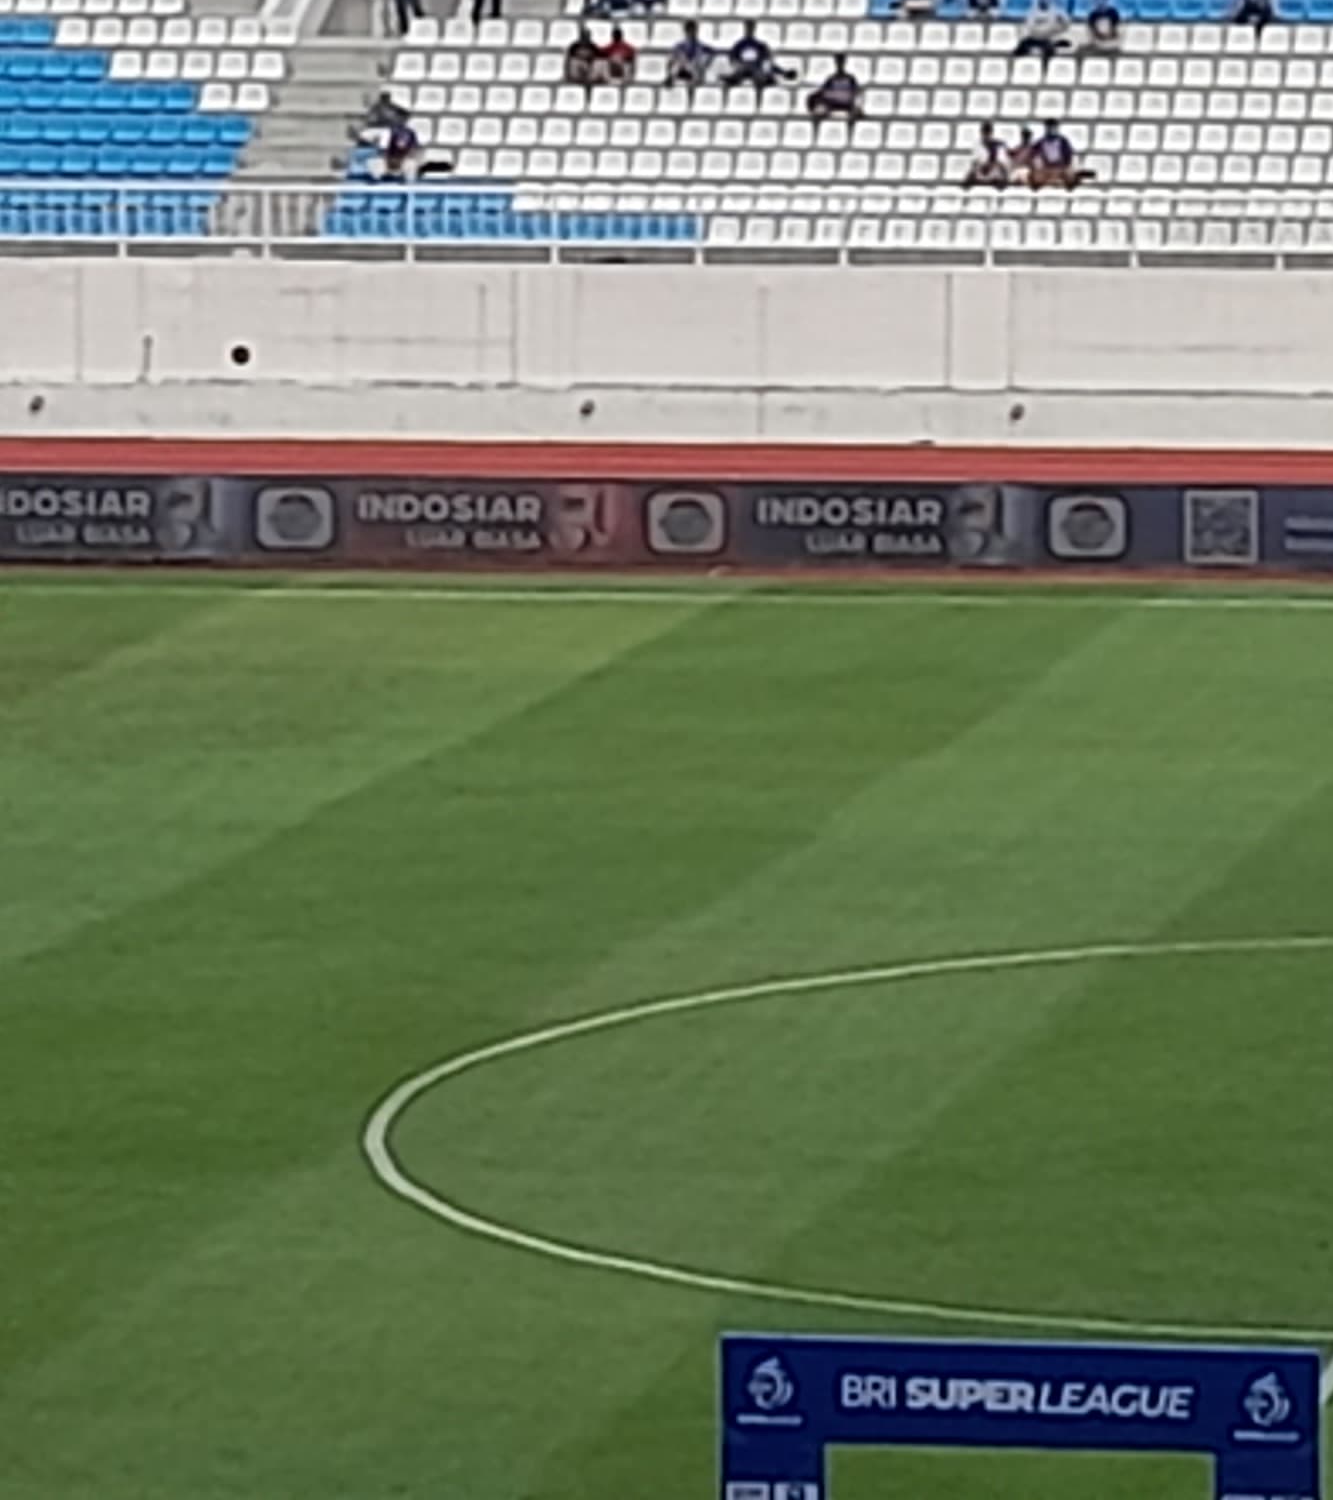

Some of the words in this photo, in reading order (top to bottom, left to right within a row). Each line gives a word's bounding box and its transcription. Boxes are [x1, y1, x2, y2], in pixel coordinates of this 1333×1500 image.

[358, 494, 541, 522] INDOSIAR
[757, 497, 942, 525] INDOSIAR
[840, 1374, 898, 1408] BRI
[905, 1377, 1036, 1413] SUPER
[1037, 1382, 1194, 1419] LEAGUE
